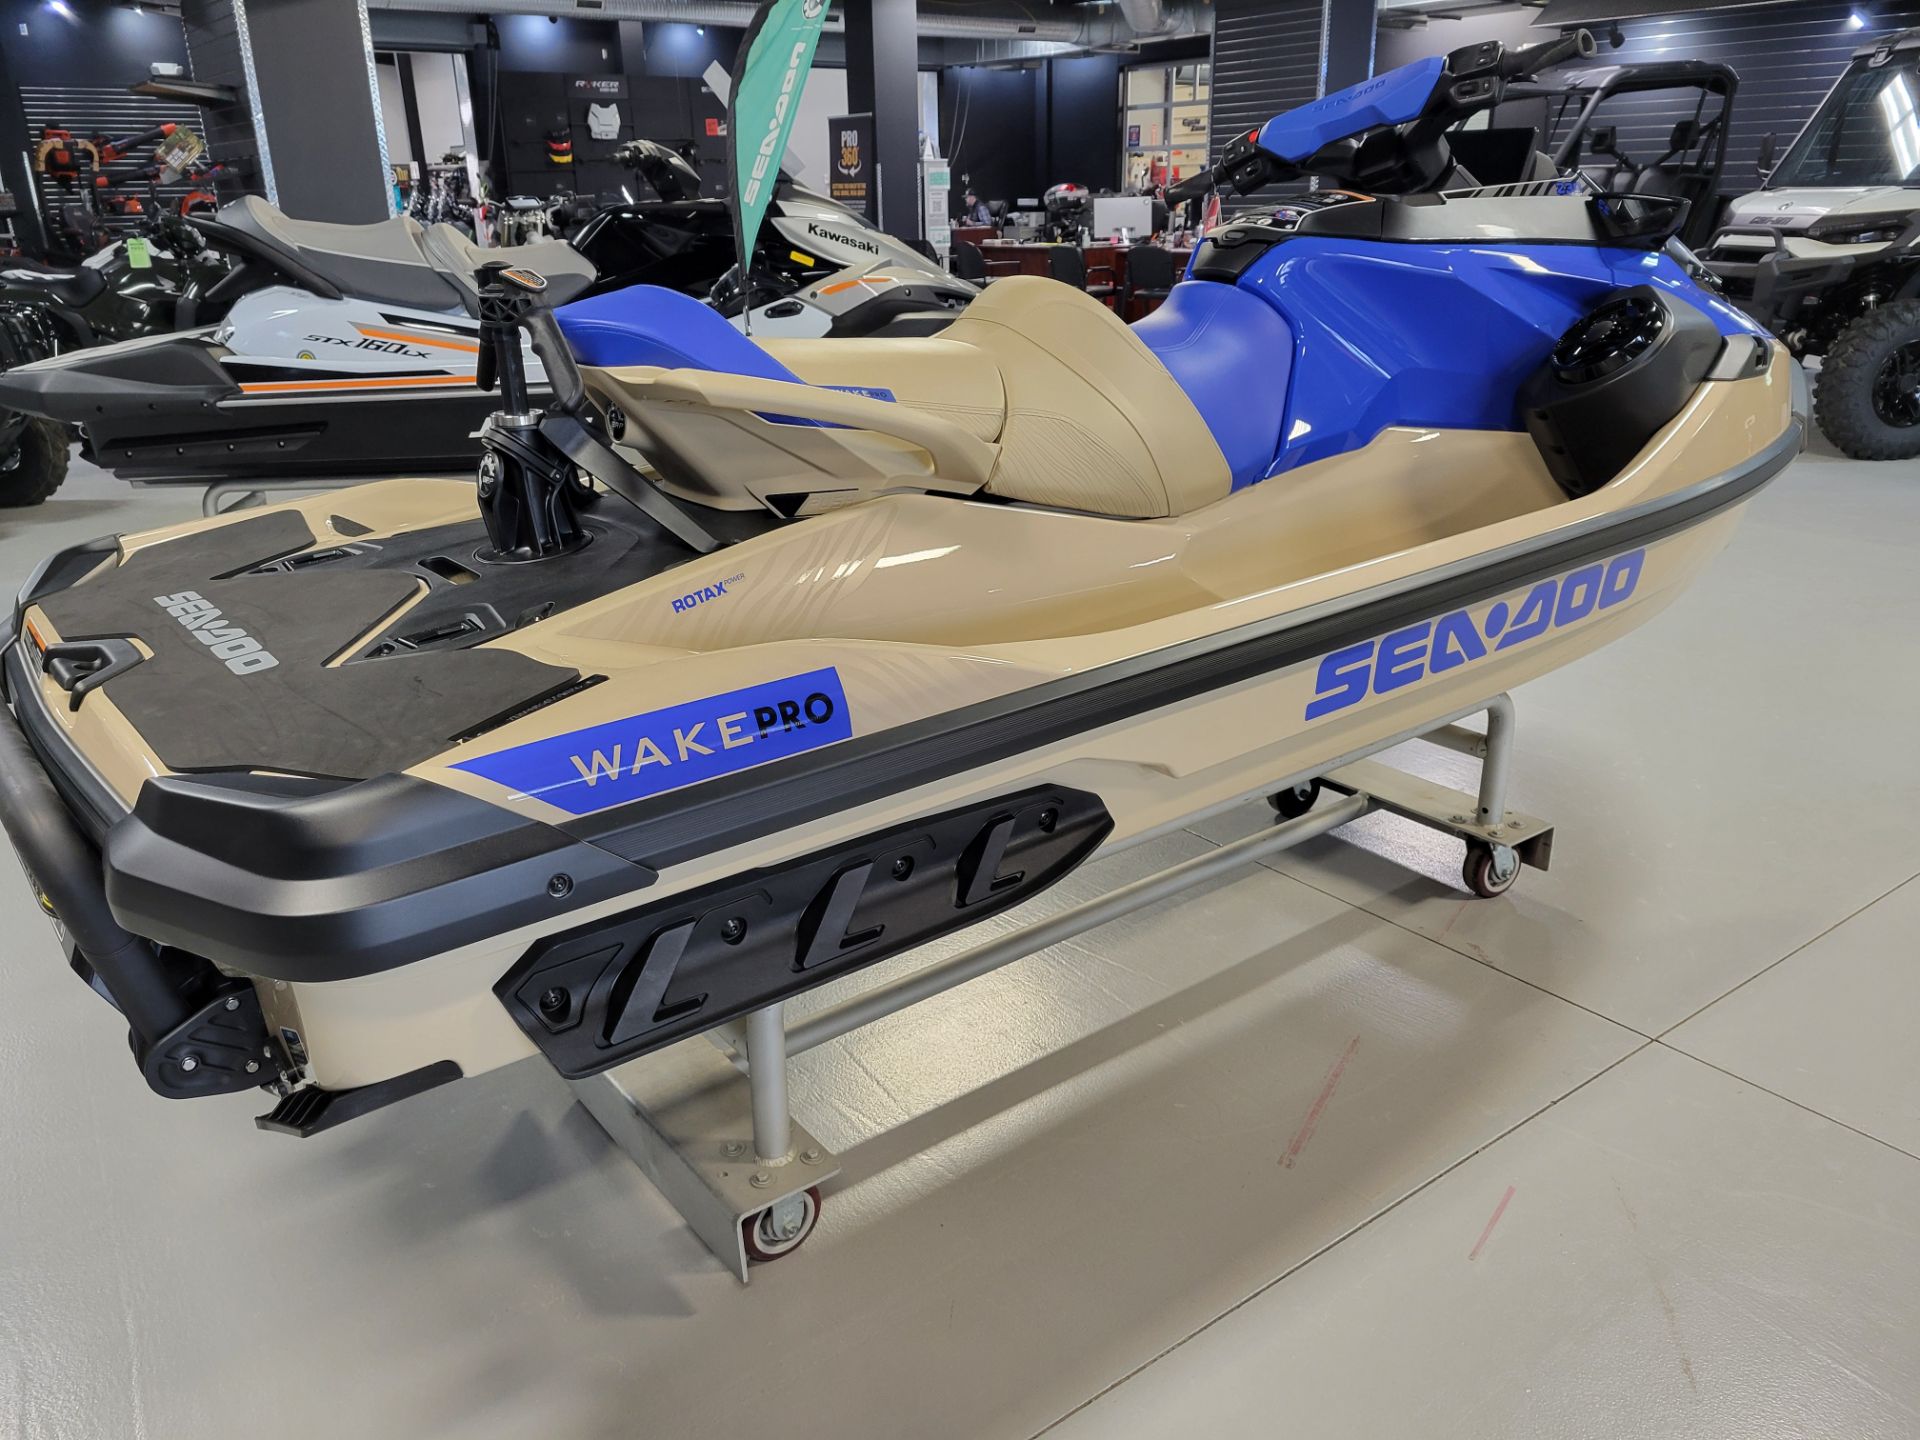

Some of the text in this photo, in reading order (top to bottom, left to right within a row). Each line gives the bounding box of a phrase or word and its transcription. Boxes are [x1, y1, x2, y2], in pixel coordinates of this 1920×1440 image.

[841, 130, 858, 148] PRO
[808, 222, 879, 255] Kawasaki
[303, 334, 354, 347] STX
[671, 572, 745, 614] ROTAX POWER
